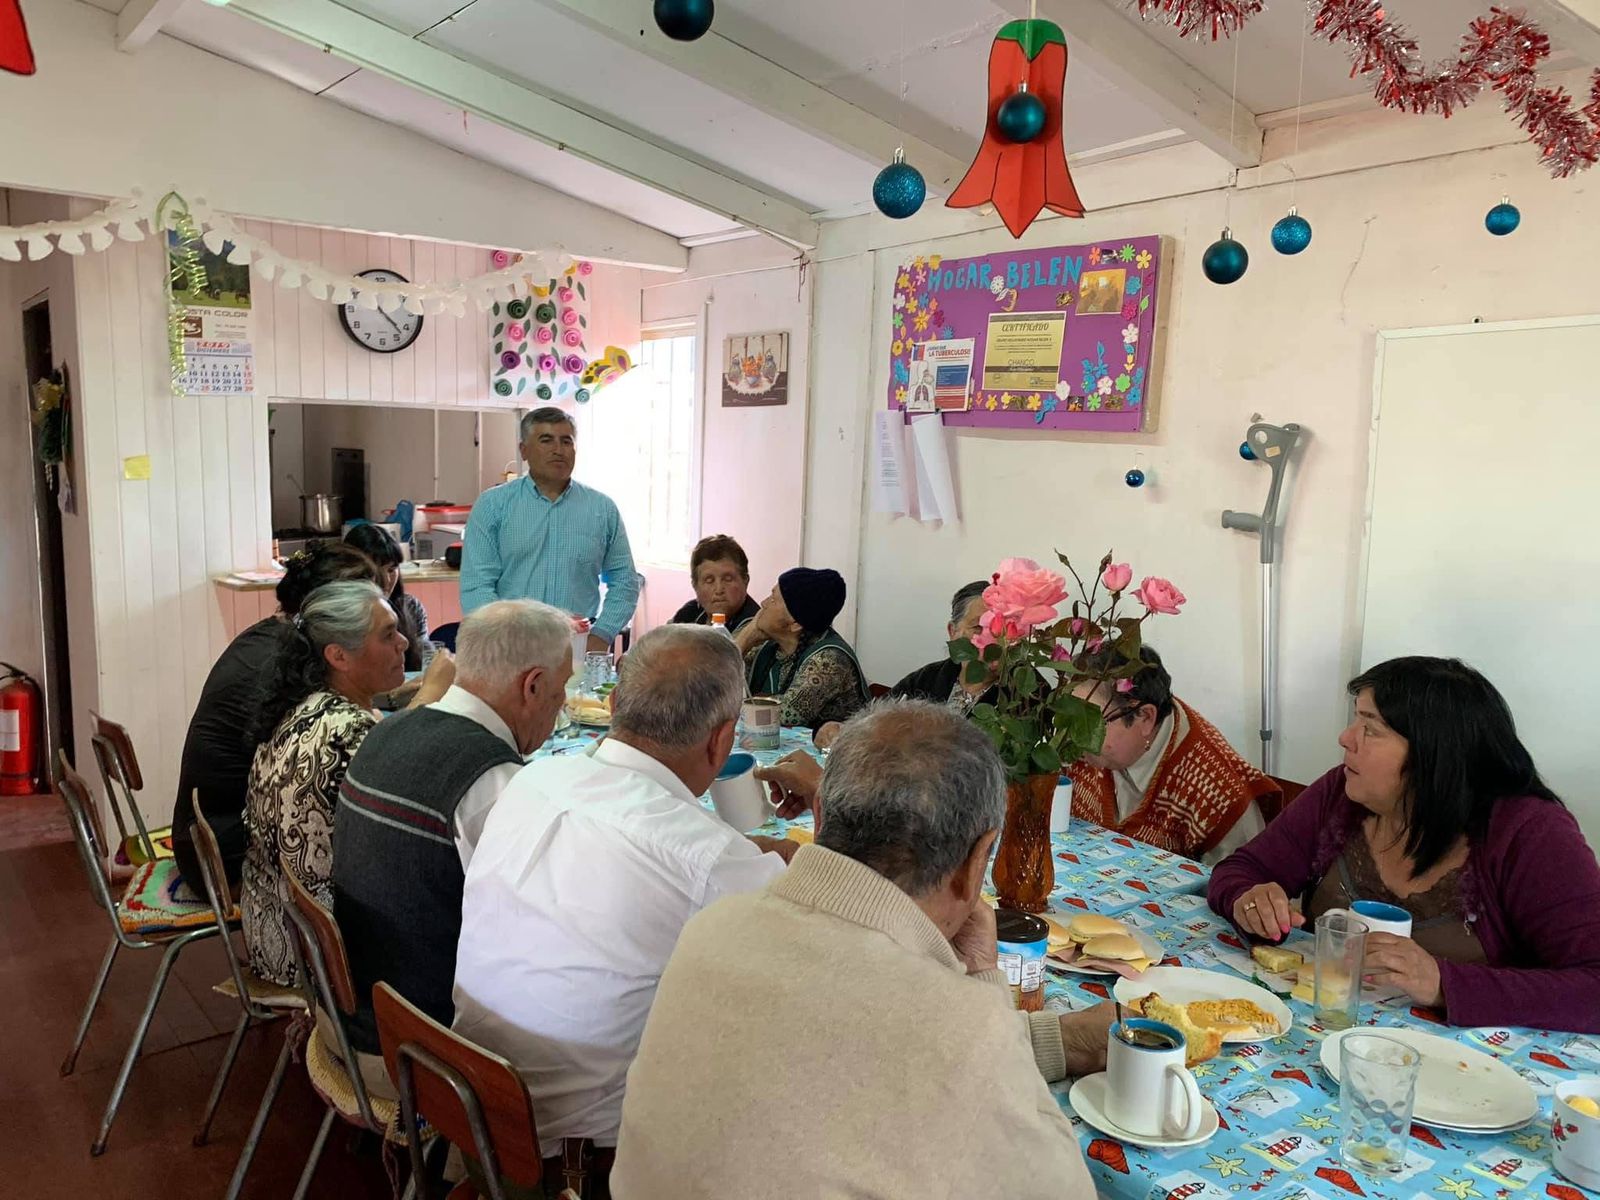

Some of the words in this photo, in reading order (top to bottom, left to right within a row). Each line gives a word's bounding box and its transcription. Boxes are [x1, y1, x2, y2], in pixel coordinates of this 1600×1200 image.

[928, 262, 992, 293] HOGAR
[1007, 255, 1083, 289] BELEN
[214, 310, 248, 318] COLOR
[1001, 322, 1050, 332] CERTIFICADO
[380, 338, 386, 346] 6
